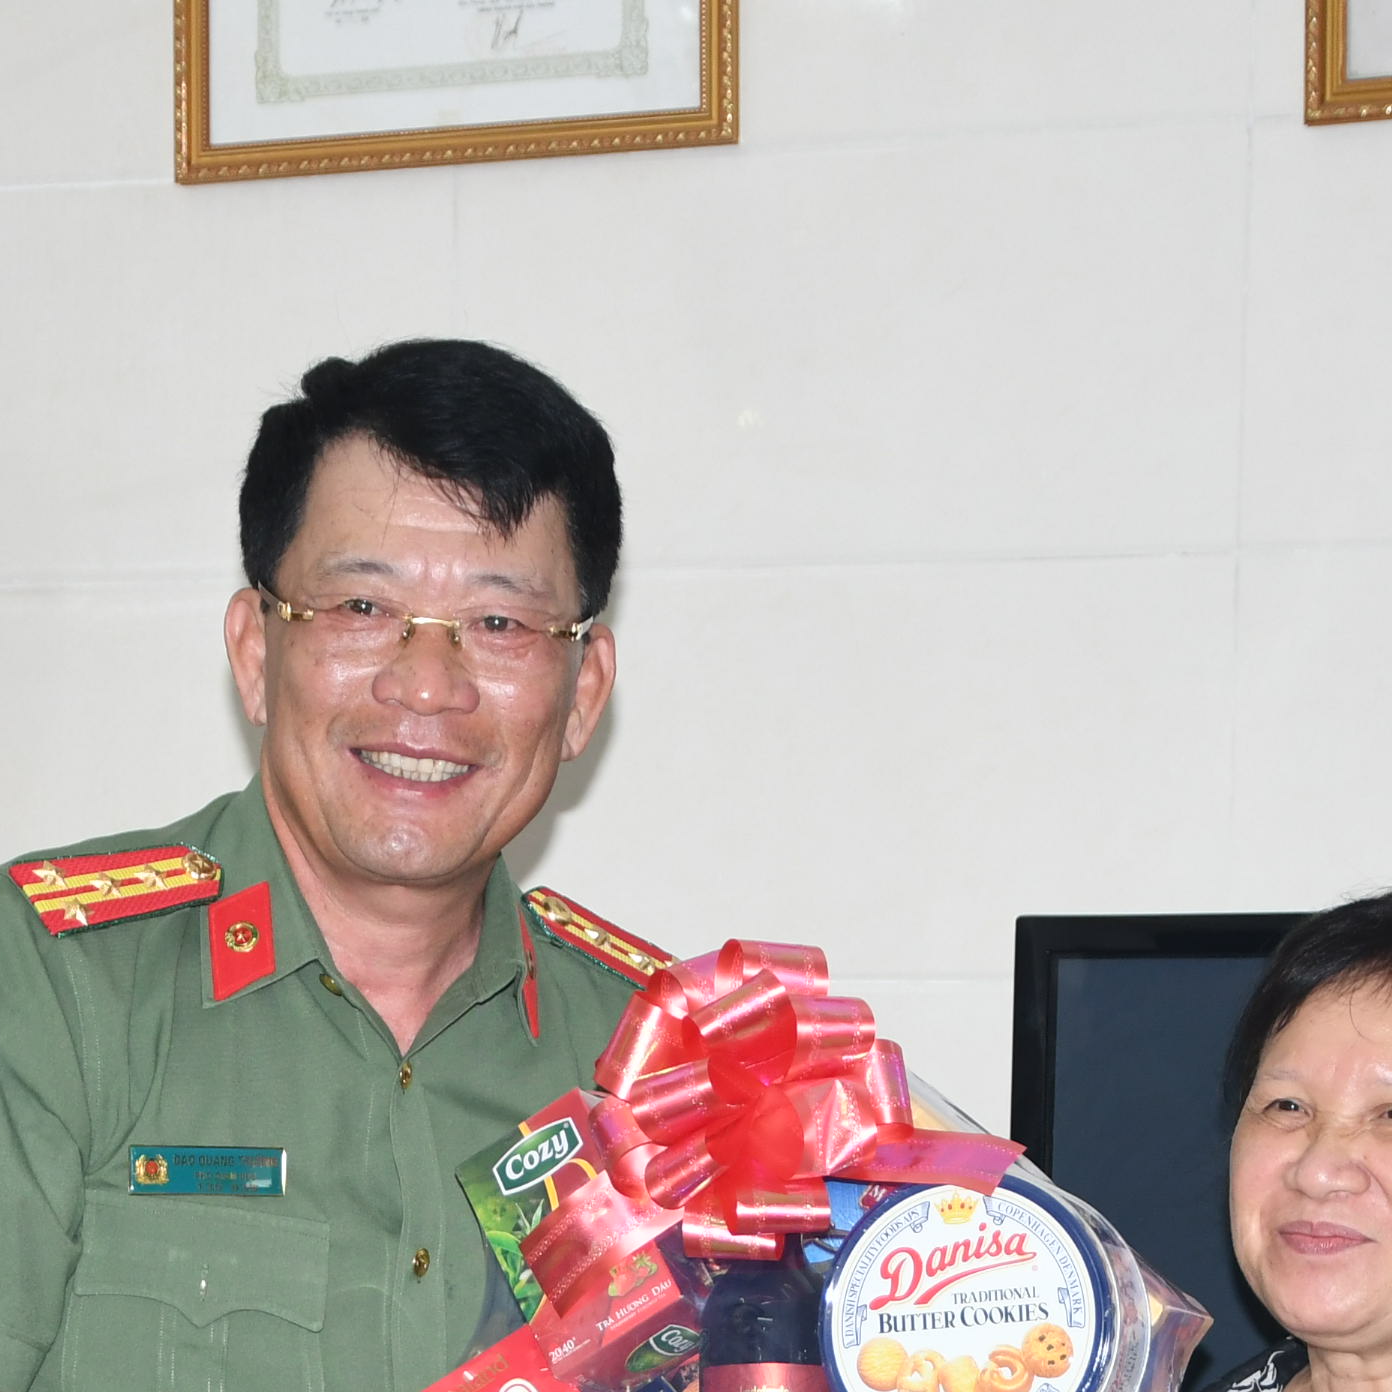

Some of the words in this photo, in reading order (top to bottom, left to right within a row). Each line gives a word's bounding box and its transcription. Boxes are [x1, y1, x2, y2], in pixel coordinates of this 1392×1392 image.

[505, 1129, 569, 1180] Cozy
[876, 1219, 904, 1247] FOODS
[848, 1245, 879, 1299] SPECIALITY
[869, 1222, 1037, 1310] Danisa
[998, 1203, 1062, 1255] COPENHAGEN
[1058, 1254, 1084, 1315] DENMARK
[844, 1299, 856, 1337] DANISH
[878, 1310, 956, 1334] BUTTER
[960, 1302, 1049, 1328] COOKIES
[952, 1286, 1040, 1306] TRADITIONAL
